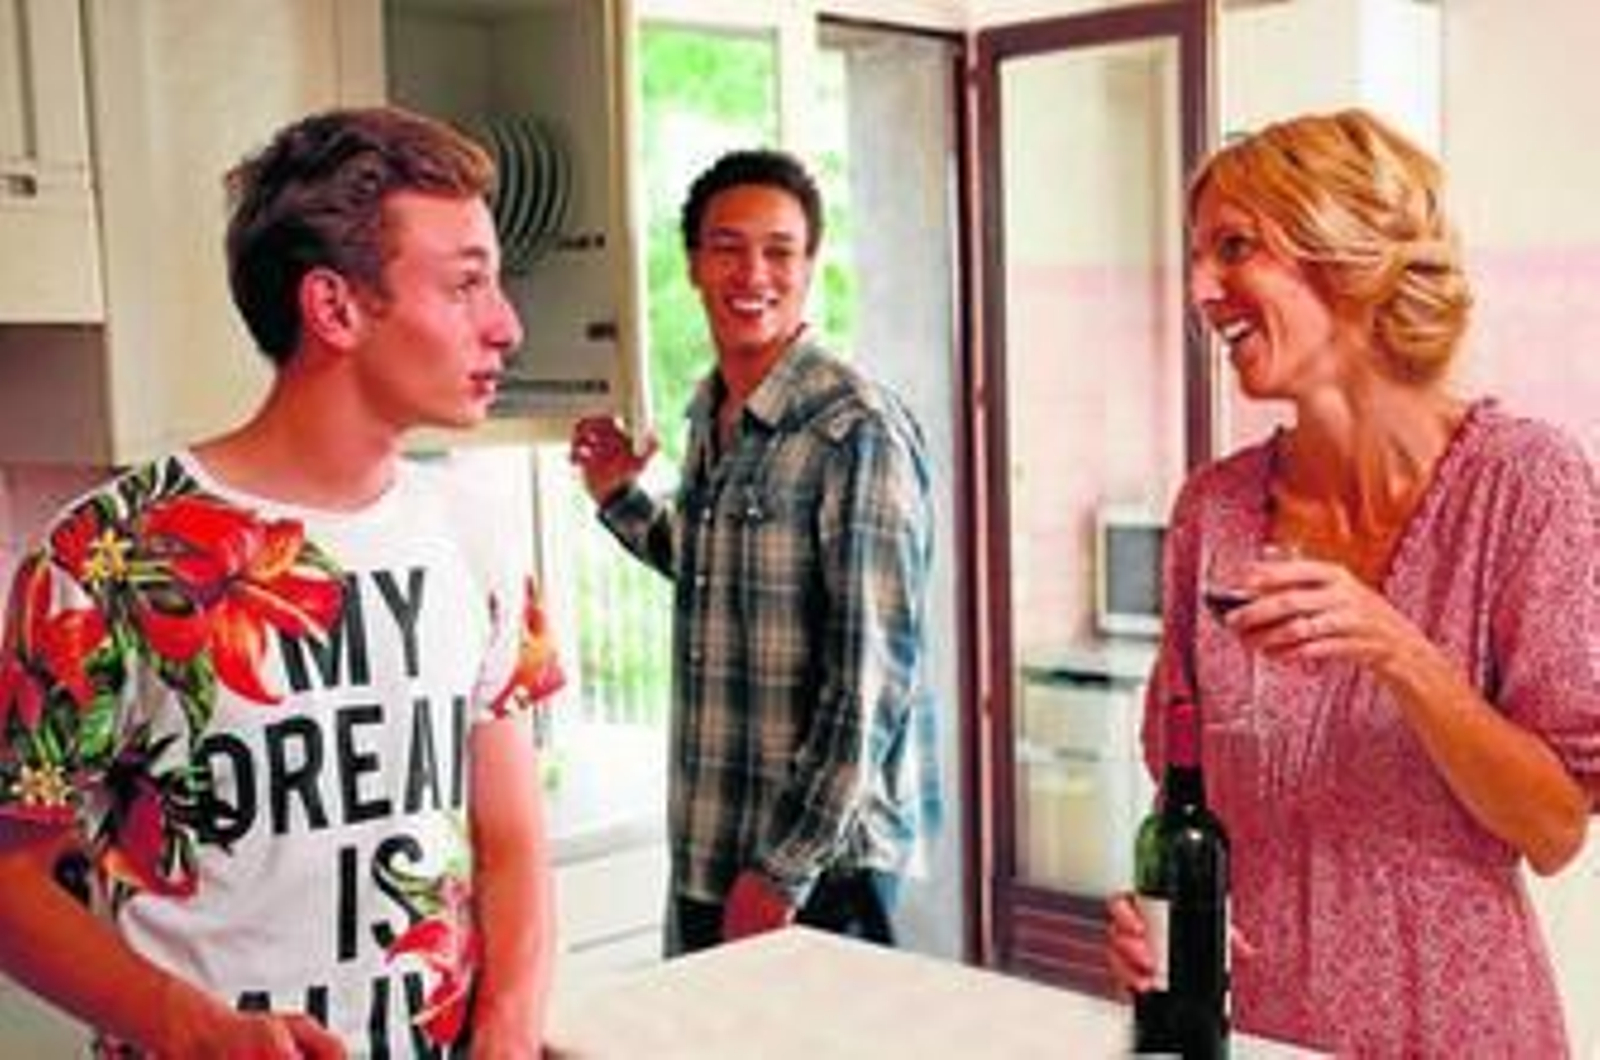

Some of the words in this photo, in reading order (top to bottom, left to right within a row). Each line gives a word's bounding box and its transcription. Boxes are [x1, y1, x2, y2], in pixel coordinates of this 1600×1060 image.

[276, 566, 427, 692] MY
[197, 694, 469, 846] DREA
[337, 833, 425, 962] IS
